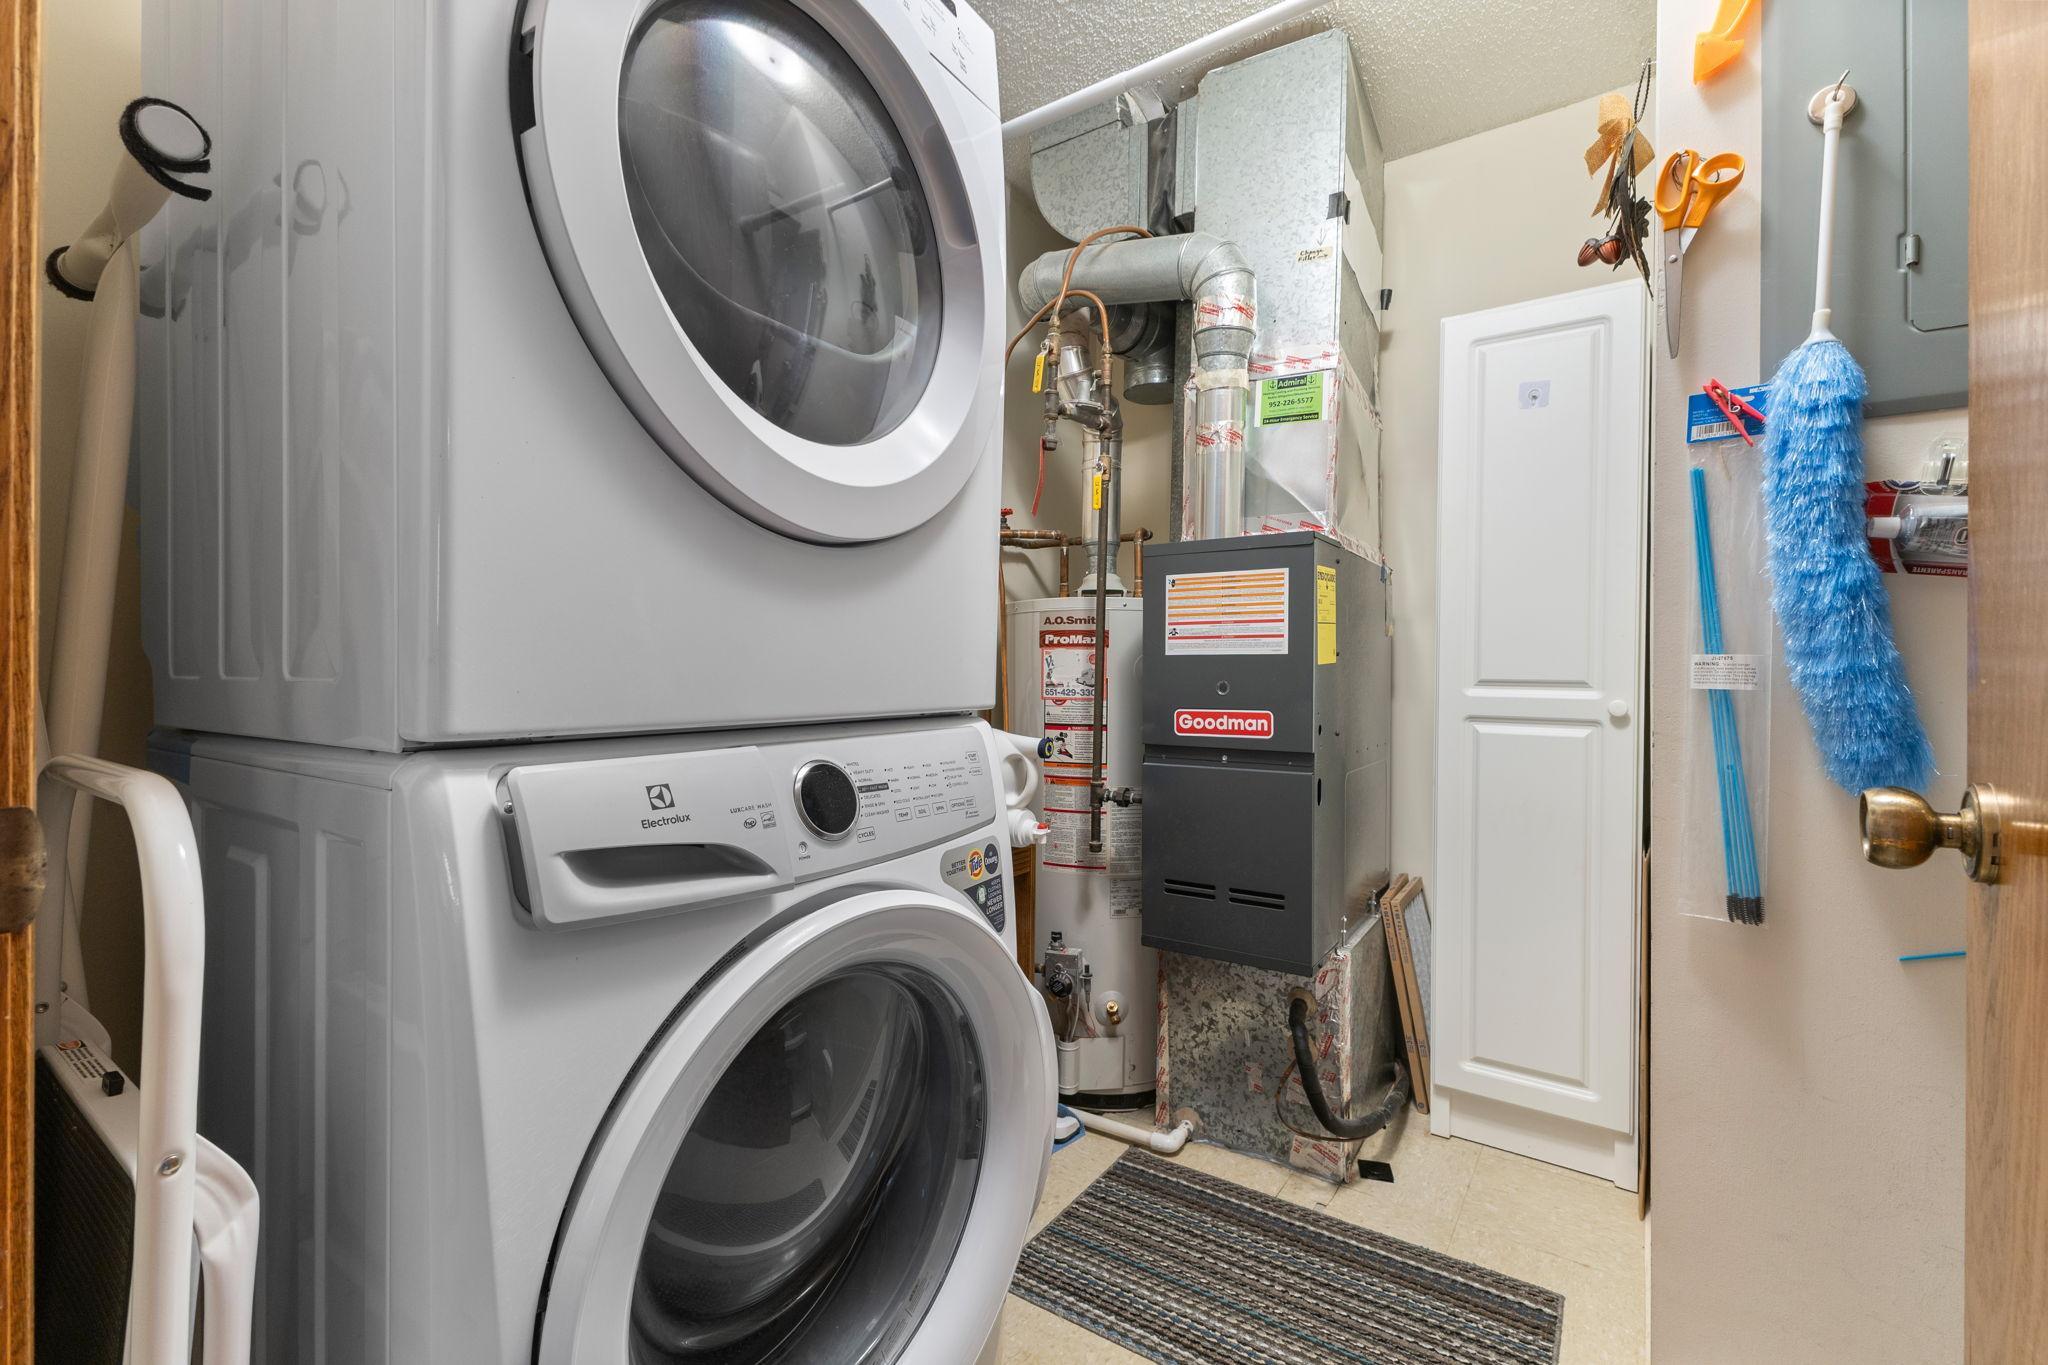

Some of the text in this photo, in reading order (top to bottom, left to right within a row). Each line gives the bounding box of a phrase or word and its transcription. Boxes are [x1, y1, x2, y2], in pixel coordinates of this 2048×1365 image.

[1278, 377, 1307, 388] Admiral
[1268, 396, 1314, 408] 952-226-5577
[1280, 415, 1302, 423] Emergency
[1912, 566, 1968, 576] RANSPARENTE
[1044, 616, 1096, 625] A.O.Smit
[1178, 714, 1268, 732] Goodman
[730, 802, 772, 814] LUXCARE WASH
[641, 814, 691, 829] Electrolux
[858, 830, 875, 839] CYCLES
[951, 859, 966, 869] BETTER
[969, 856, 983, 876] Tide
[985, 856, 998, 865] Downy
[946, 865, 966, 877] TOGETHER
[987, 895, 1003, 906] NEWER
[986, 902, 1003, 915] LONGER
